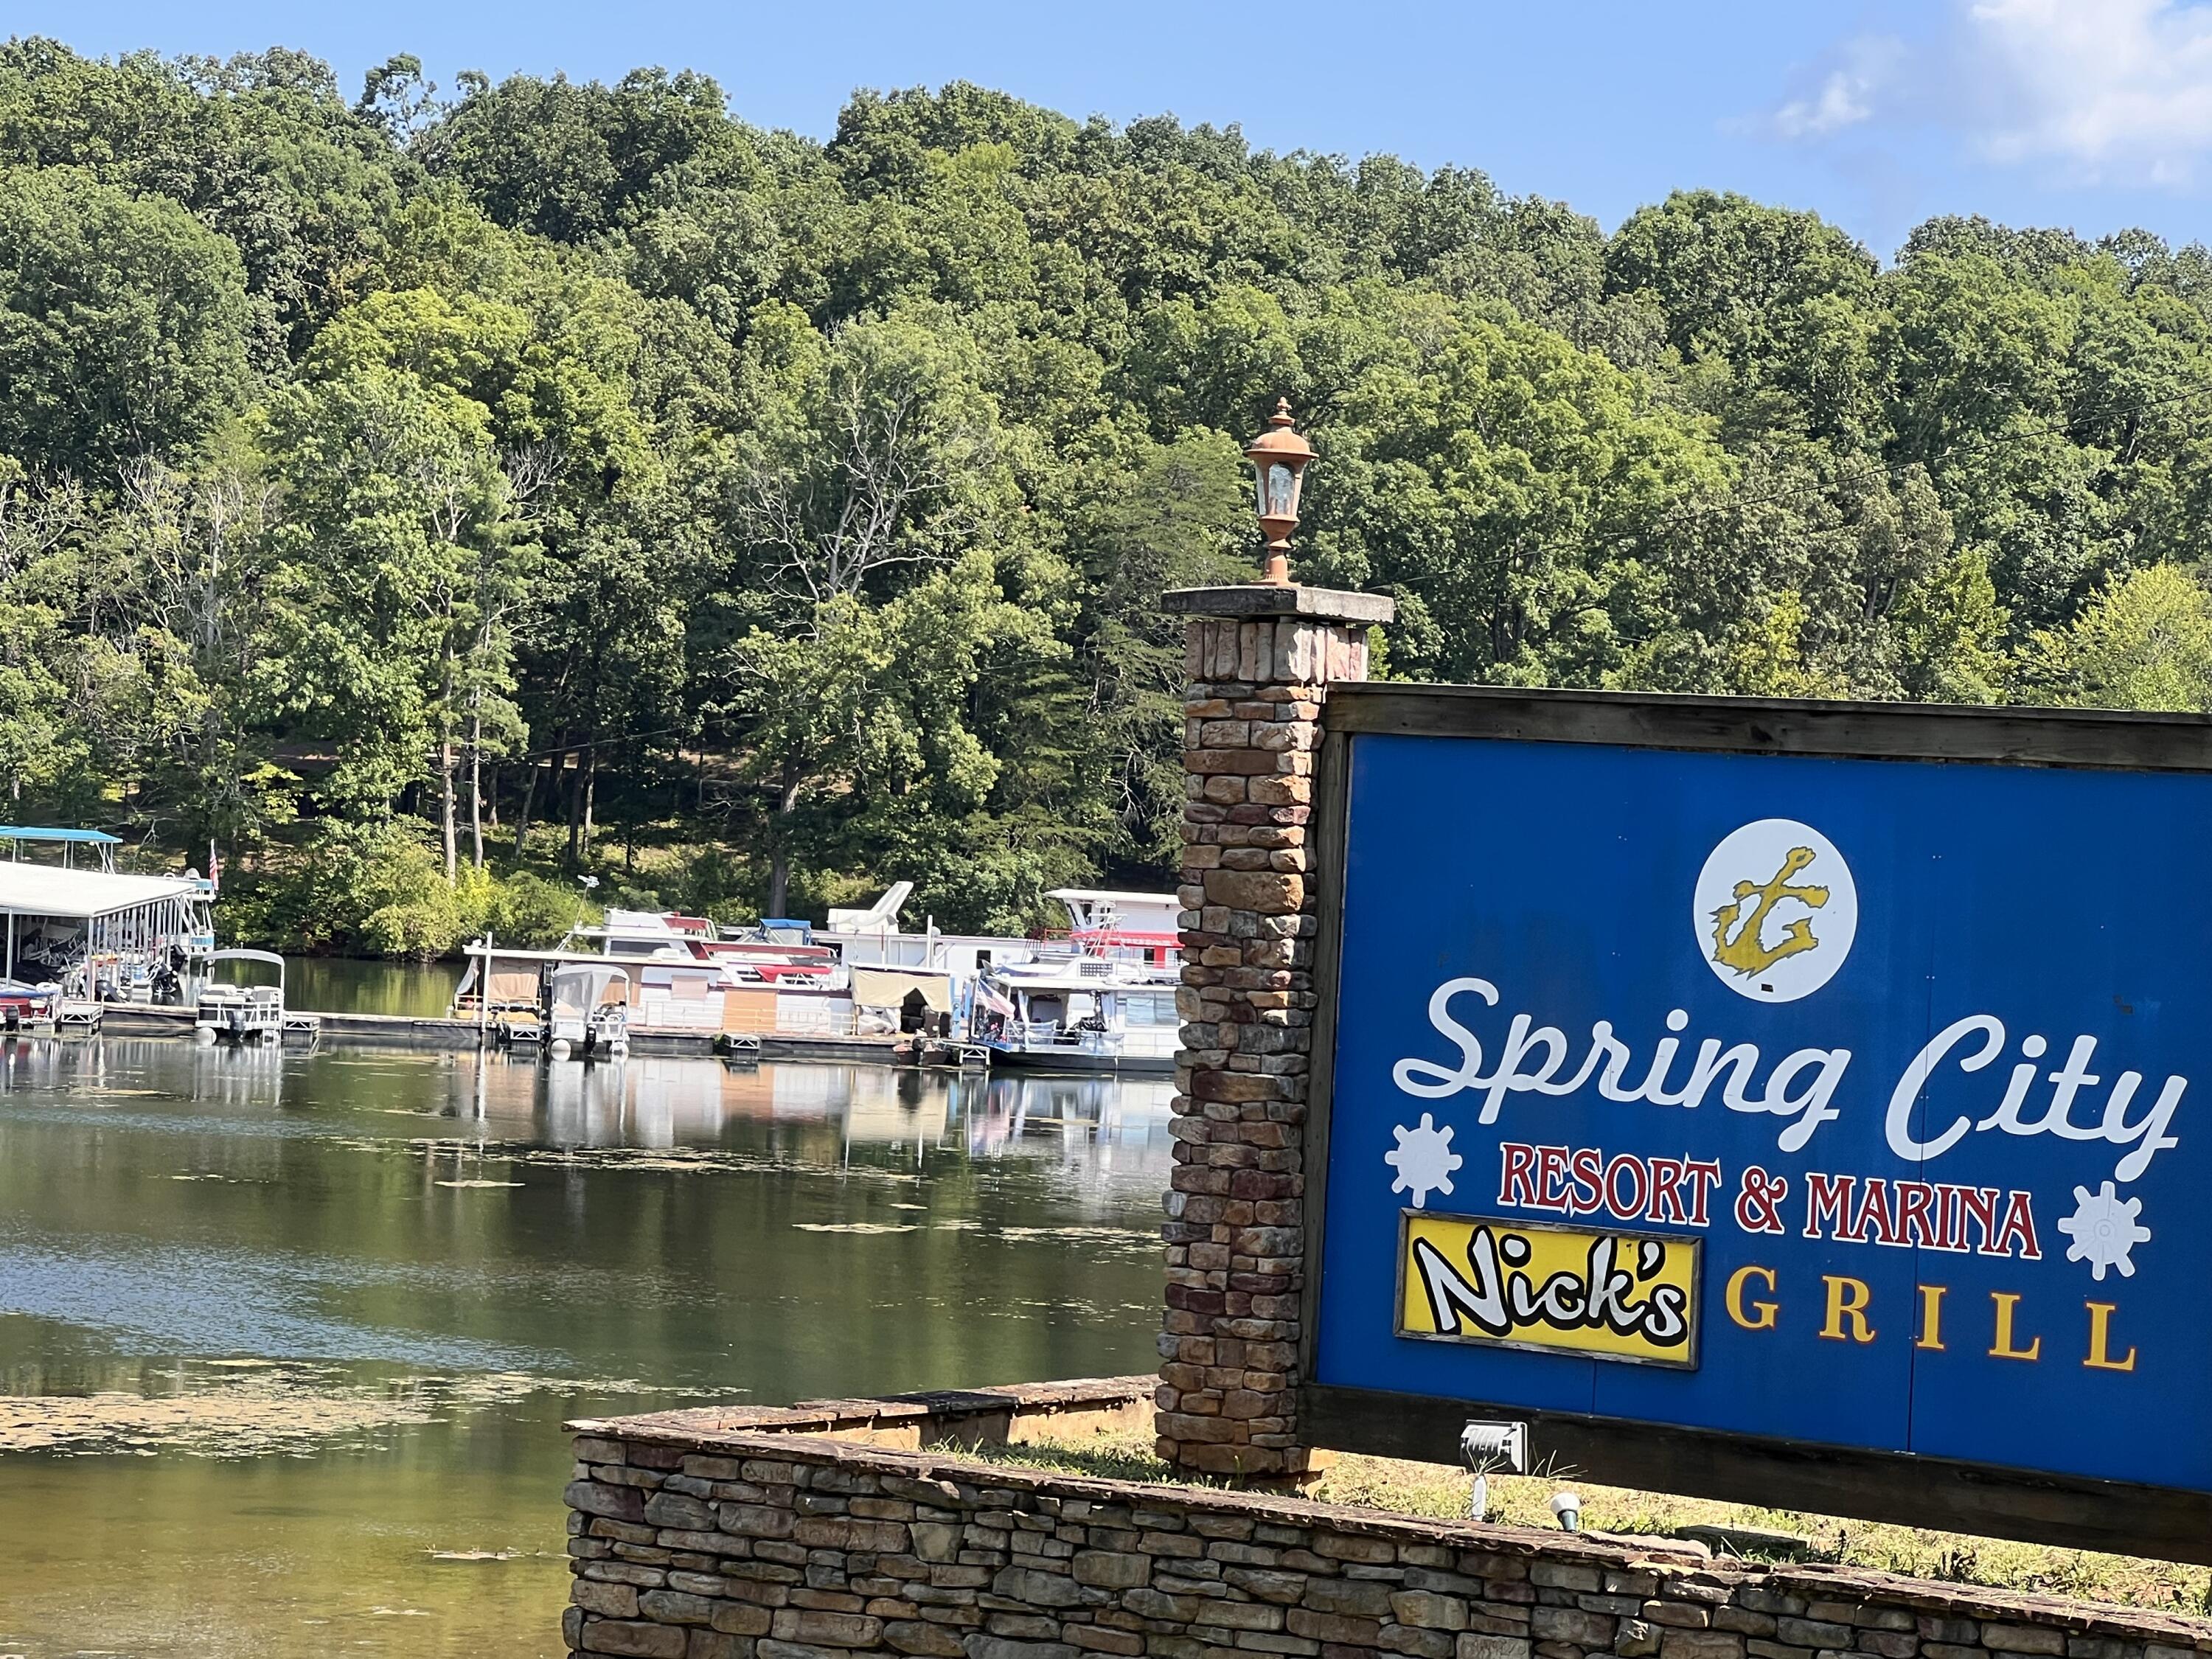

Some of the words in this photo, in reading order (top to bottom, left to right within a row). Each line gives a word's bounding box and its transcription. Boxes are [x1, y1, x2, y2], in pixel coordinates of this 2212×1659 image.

[1392, 978, 1852, 1152] Spring
[1885, 1014, 2188, 1183] City
[1498, 1142, 1722, 1227] RESORT
[1734, 1166, 1788, 1235] &
[1804, 1172, 2042, 1260] MARINA
[1412, 1225, 1691, 1347] Nick's
[1724, 1265, 2138, 1373] GRILL
